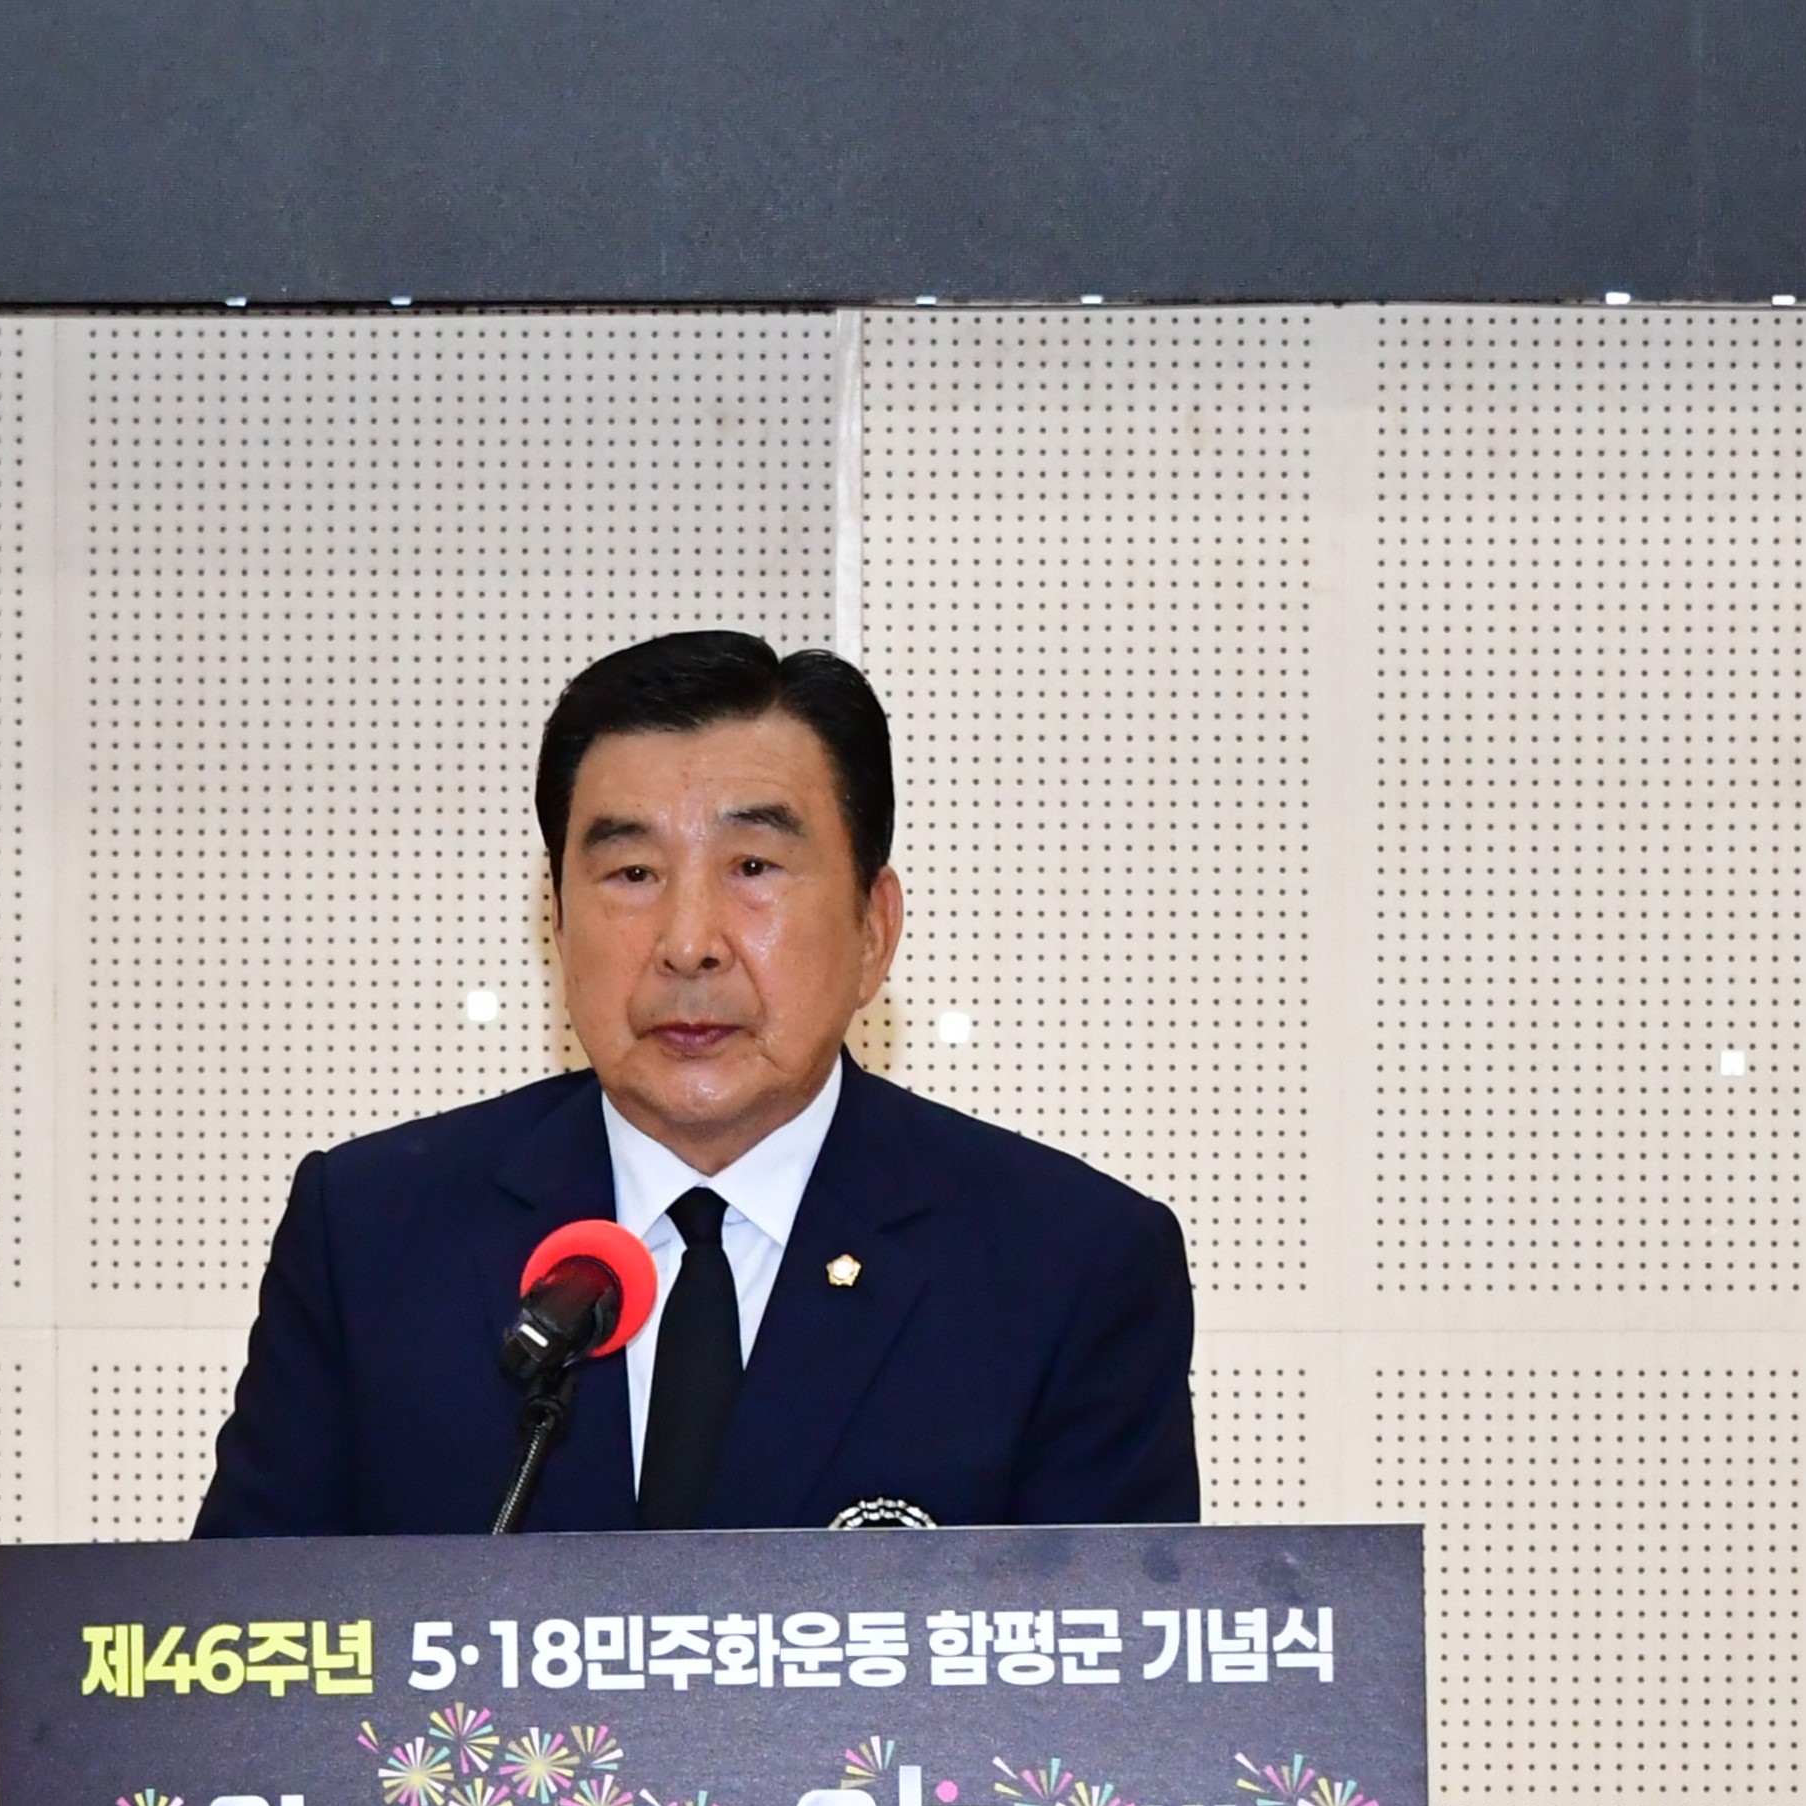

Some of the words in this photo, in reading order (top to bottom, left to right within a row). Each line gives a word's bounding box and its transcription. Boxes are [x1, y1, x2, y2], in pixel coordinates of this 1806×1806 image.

[82, 1619, 374, 1698] 제46주년
[407, 1611, 910, 1691] 5·18민주화운동
[926, 1609, 1123, 1687] 함평군
[1141, 1607, 1335, 1683] 기념식
